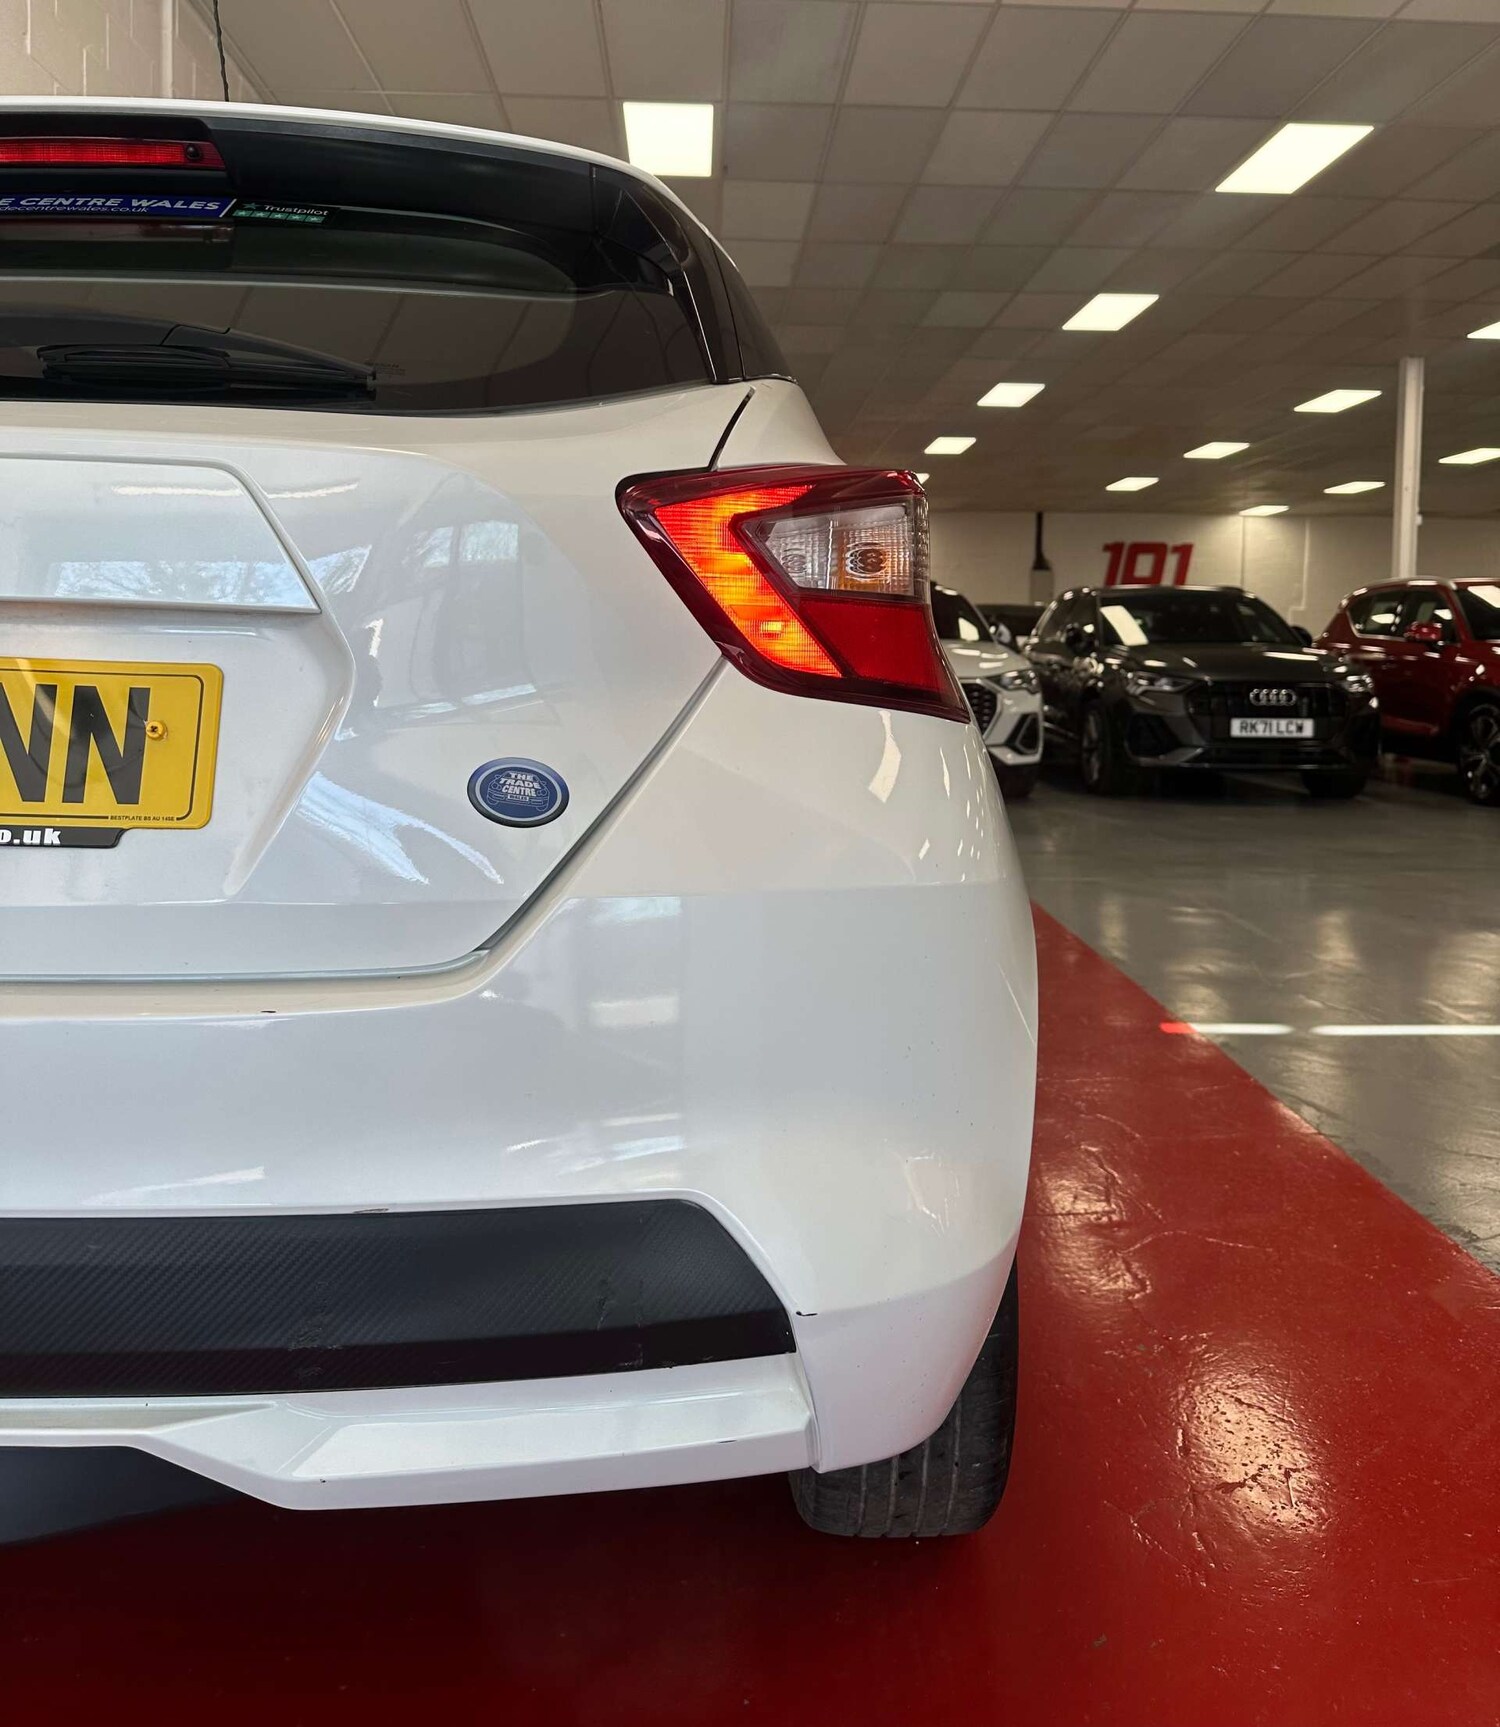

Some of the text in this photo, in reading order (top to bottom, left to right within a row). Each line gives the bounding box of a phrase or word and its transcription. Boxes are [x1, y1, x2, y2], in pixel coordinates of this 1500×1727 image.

[20, 198, 124, 206] CENTRE
[131, 199, 221, 210] WALES
[264, 205, 329, 216] Trustpilot
[1102, 541, 1194, 587] 101
[509, 772, 534, 781] THE
[499, 778, 541, 789] TRADE
[501, 785, 537, 797] CENTRE
